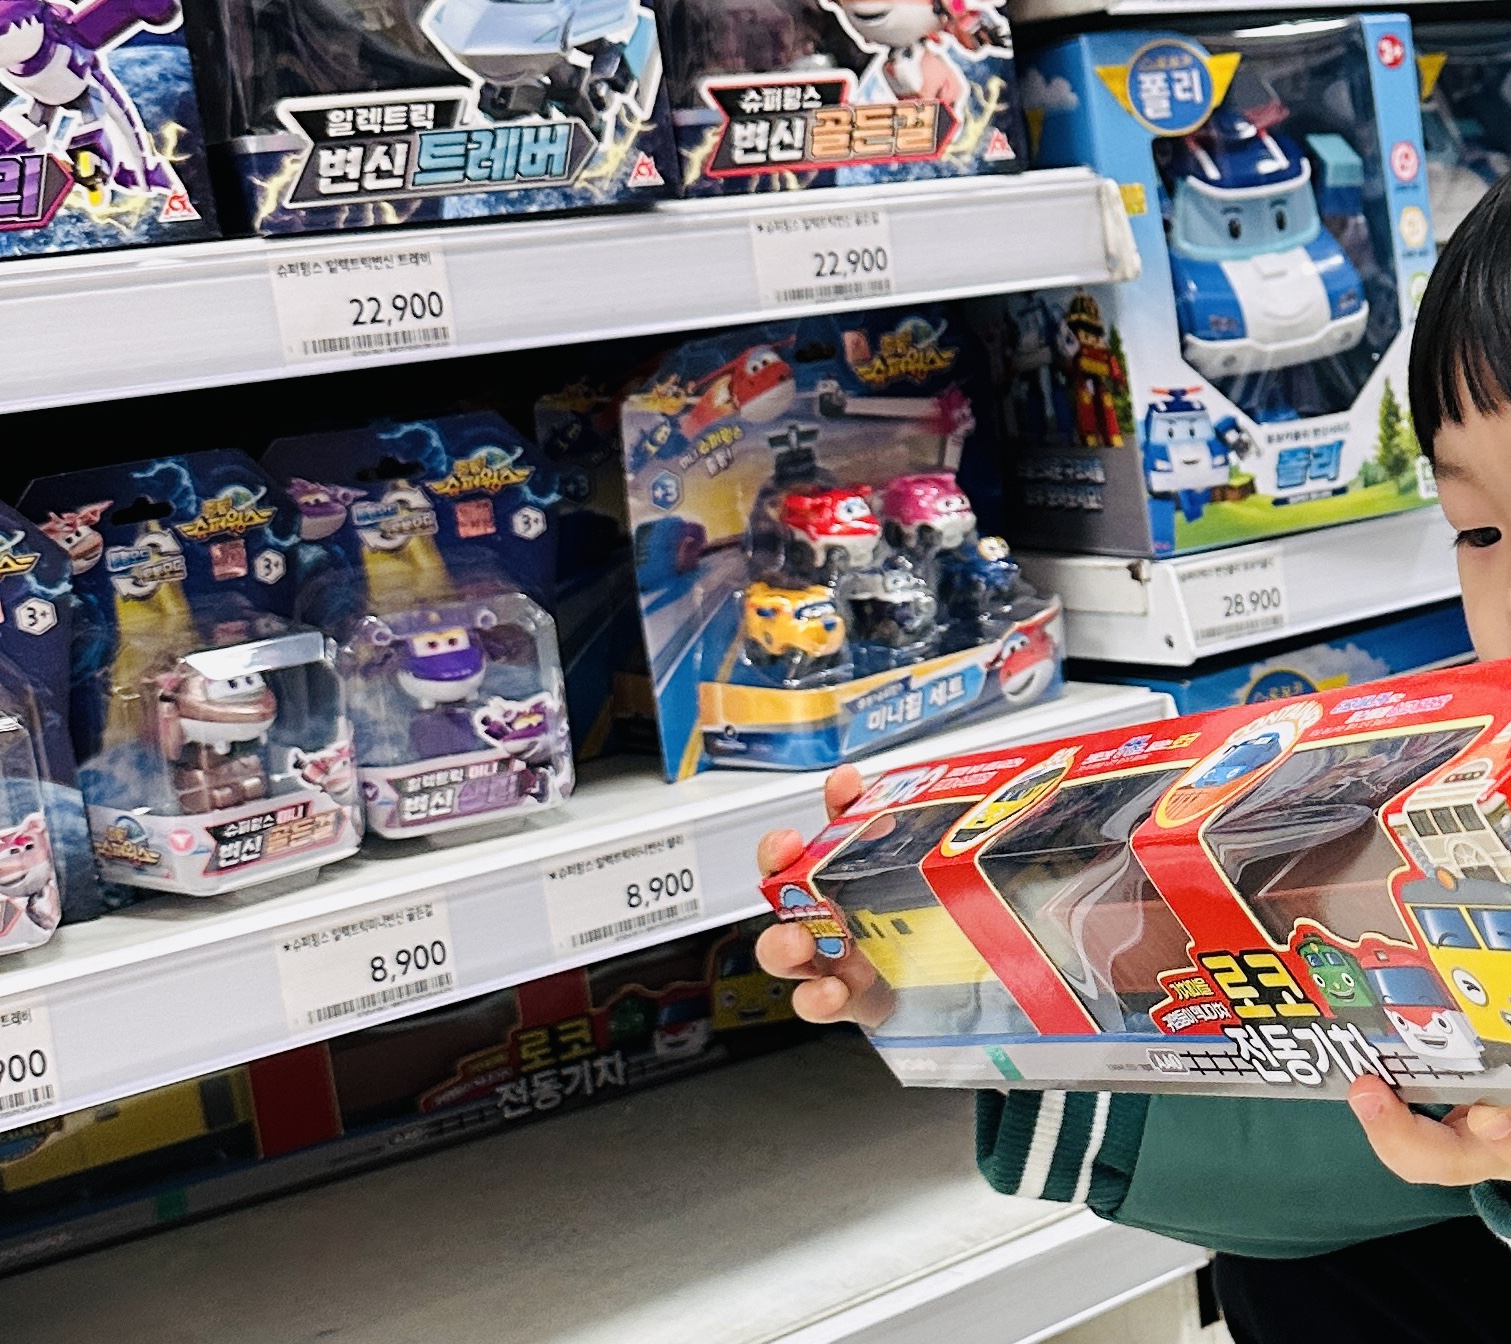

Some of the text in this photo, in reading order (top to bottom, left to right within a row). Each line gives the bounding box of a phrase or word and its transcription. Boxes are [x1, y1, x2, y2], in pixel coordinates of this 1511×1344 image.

[740, 85, 822, 114] 슈퍼윙스
[1138, 67, 1204, 120] 폴리
[326, 103, 436, 138] 일렉트릭
[731, 101, 939, 165] 변신 골든걸
[318, 122, 572, 196] 변신 트레버
[814, 246, 888, 278] 22,900
[349, 290, 444, 327] 22,900
[26, 606, 49, 627] 3+
[1223, 587, 1281, 618] 28,900
[867, 690, 924, 731] 미니휠
[930, 673, 966, 707] 세트
[468, 760, 499, 780] 미니
[403, 788, 454, 822] 변신
[219, 835, 265, 867] 변신
[627, 867, 694, 908] 8,900
[370, 939, 447, 984] 8,900
[1202, 954, 1321, 1019] 로코
[518, 1017, 597, 1073] 로코
[1223, 1022, 1398, 1086] 전동기차
[495, 1050, 628, 1119] 전동기차
